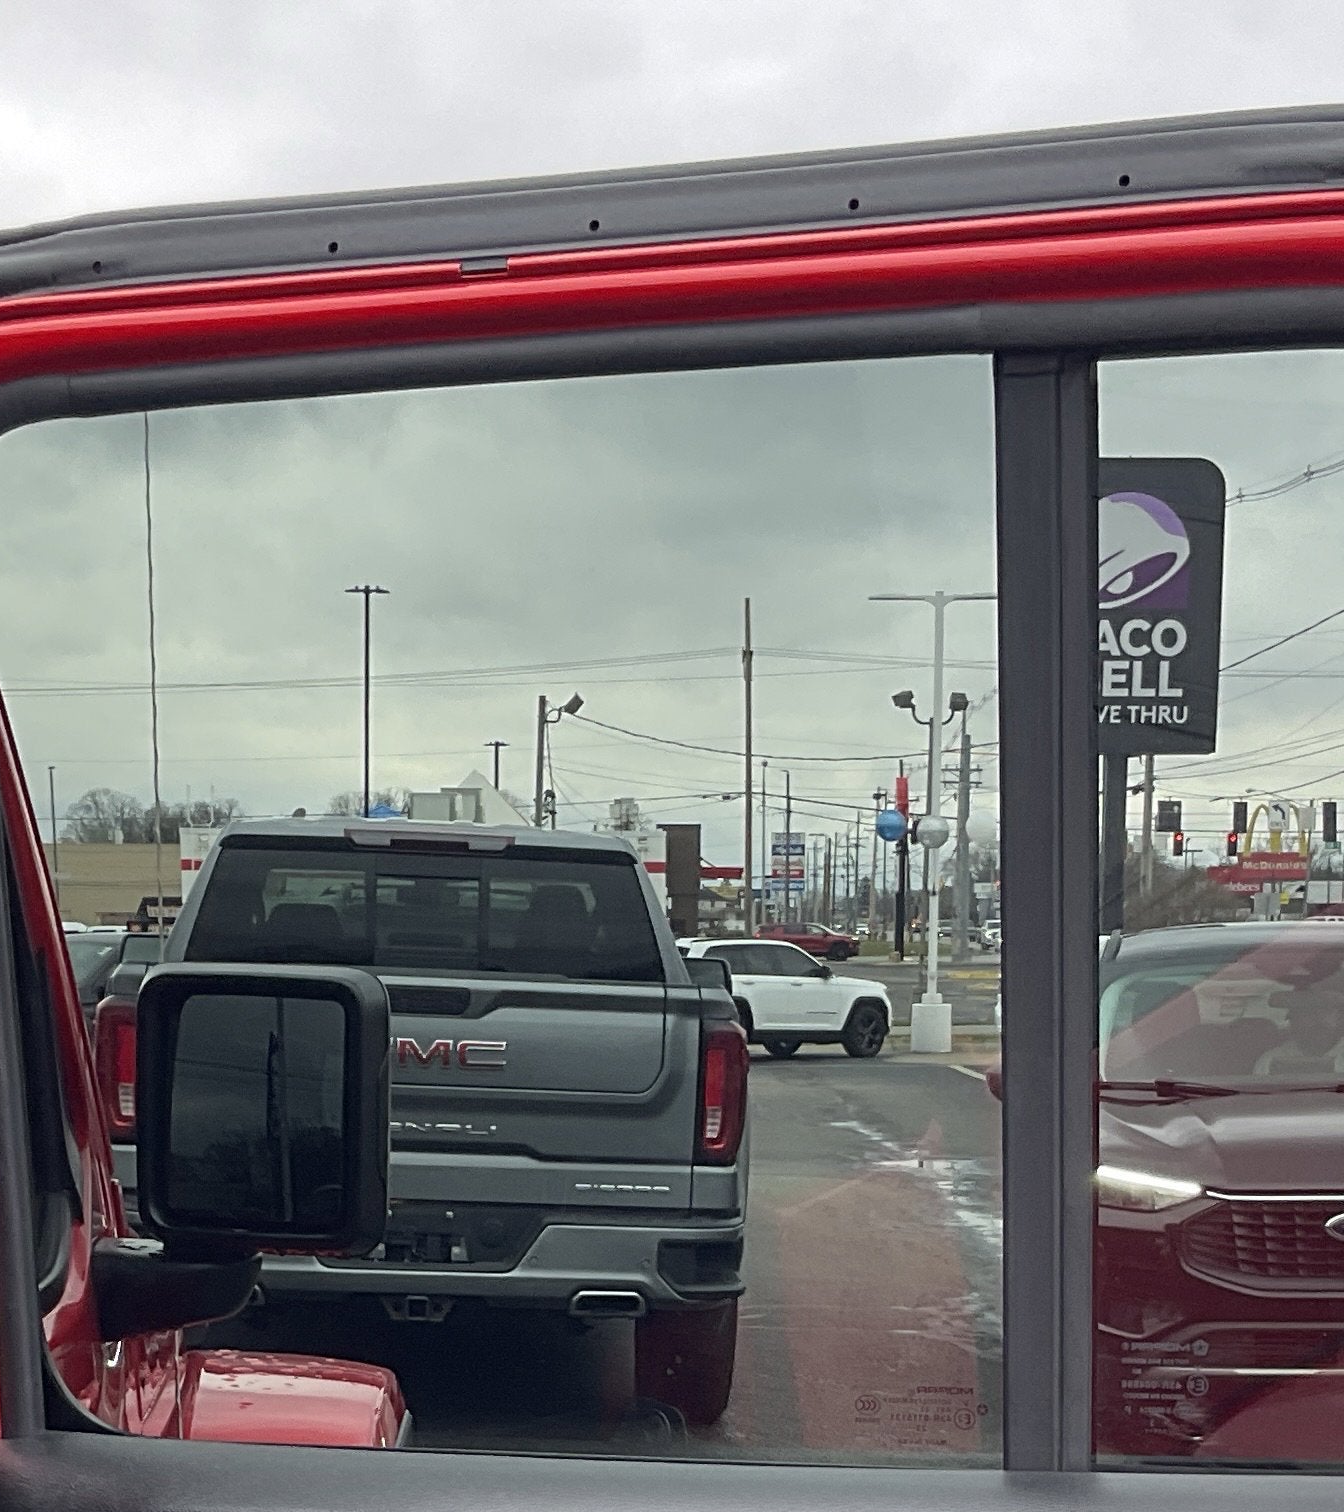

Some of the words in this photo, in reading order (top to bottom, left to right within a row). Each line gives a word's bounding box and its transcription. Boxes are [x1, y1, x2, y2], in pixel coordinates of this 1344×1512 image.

[1098, 618, 1188, 658] ACO
[1101, 660, 1184, 698] ELL
[1098, 705, 1122, 724] VE
[1126, 704, 1189, 724] THRU
[390, 1036, 507, 1070] MC
